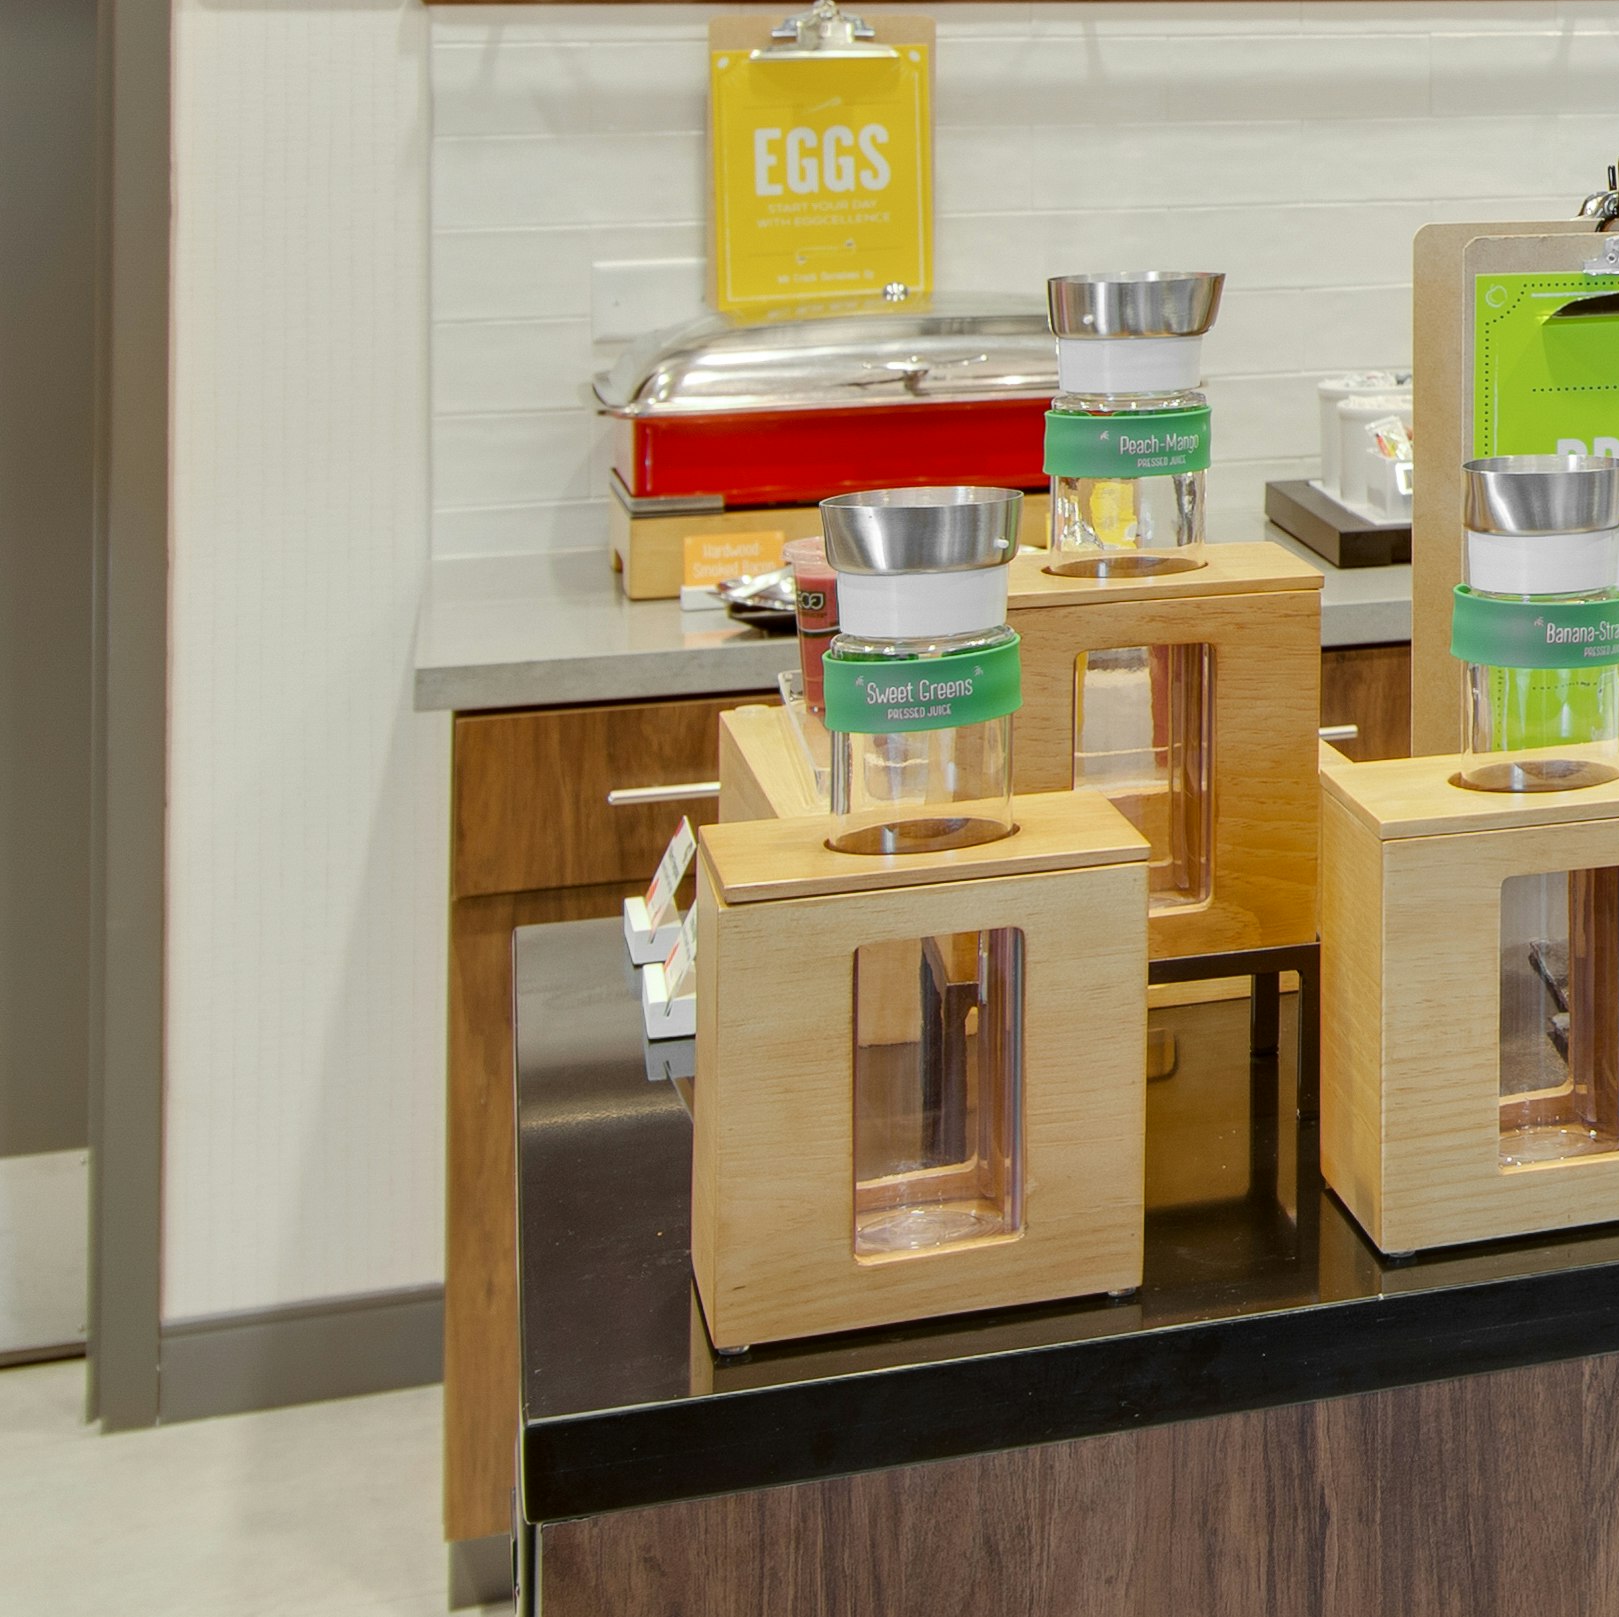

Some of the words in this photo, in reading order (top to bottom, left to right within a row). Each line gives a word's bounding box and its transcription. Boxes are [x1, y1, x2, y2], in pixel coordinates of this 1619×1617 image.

[755, 123, 891, 196] EGGS
[1120, 433, 1199, 454] Peach-Mango
[1137, 456, 1168, 468] PRESSED
[867, 682, 914, 704] Sweet
[920, 678, 973, 701] Greens
[888, 707, 925, 720] PRESSED
[927, 704, 951, 717] JUICE
